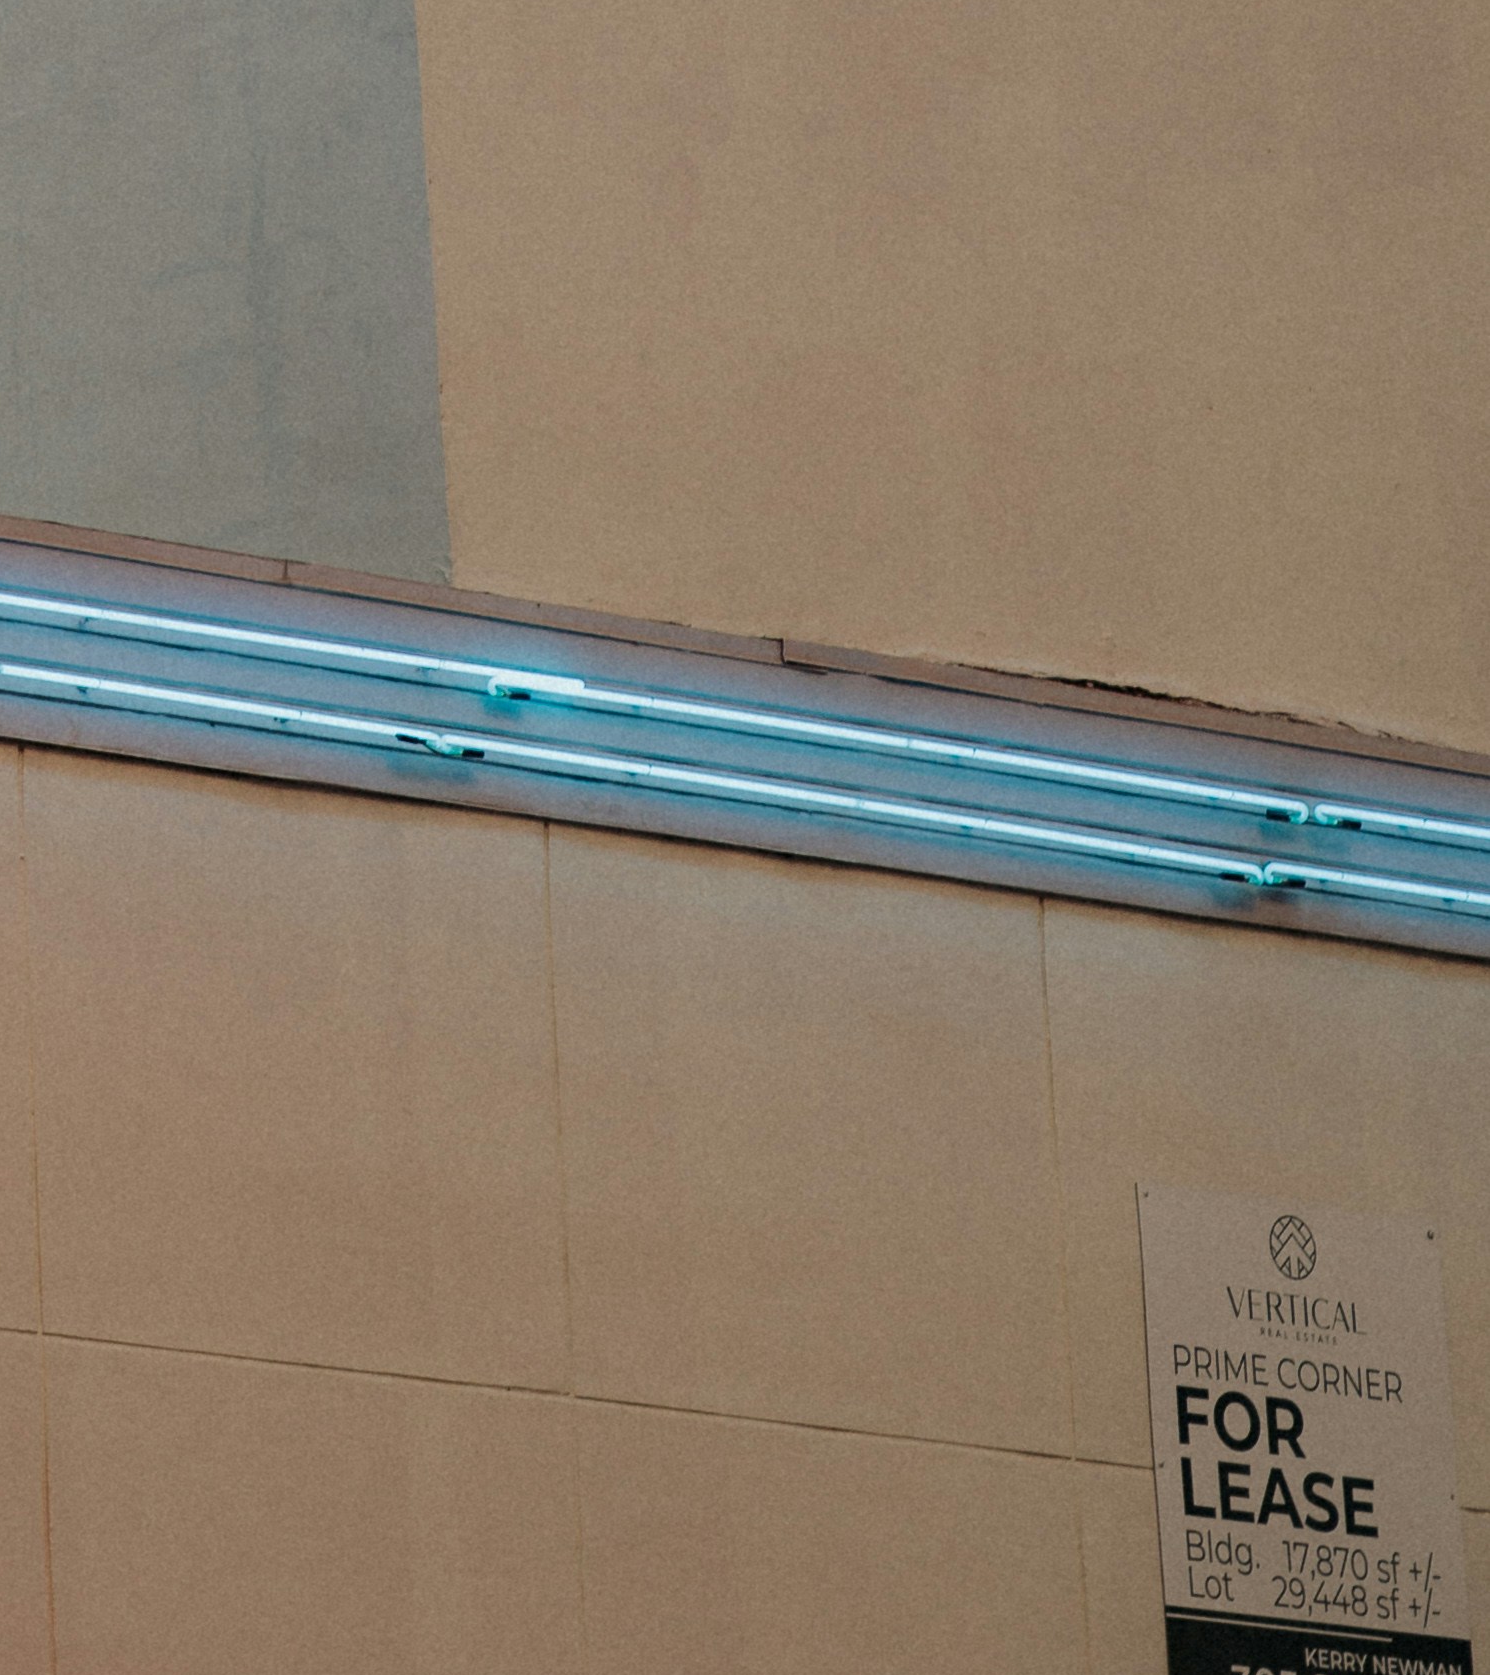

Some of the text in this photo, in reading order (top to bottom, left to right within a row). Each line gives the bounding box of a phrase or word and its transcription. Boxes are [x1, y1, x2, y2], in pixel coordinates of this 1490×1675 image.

[1226, 1286, 1367, 1335] VERTICAL
[1260, 1327, 1337, 1345] REAL ESTATE
[1173, 1344, 1403, 1403] PRIME CORNER
[1176, 1385, 1306, 1459] FOR
[1181, 1456, 1379, 1538] LEASE
[1186, 1529, 1260, 1575] Bldg.
[1282, 1540, 1368, 1581] 17,870
[1377, 1551, 1400, 1585] sf
[1188, 1566, 1234, 1602] Lot
[1272, 1575, 1368, 1616] 29,448
[1377, 1588, 1399, 1621] sf
[1304, 1647, 1368, 1673] KERRY
